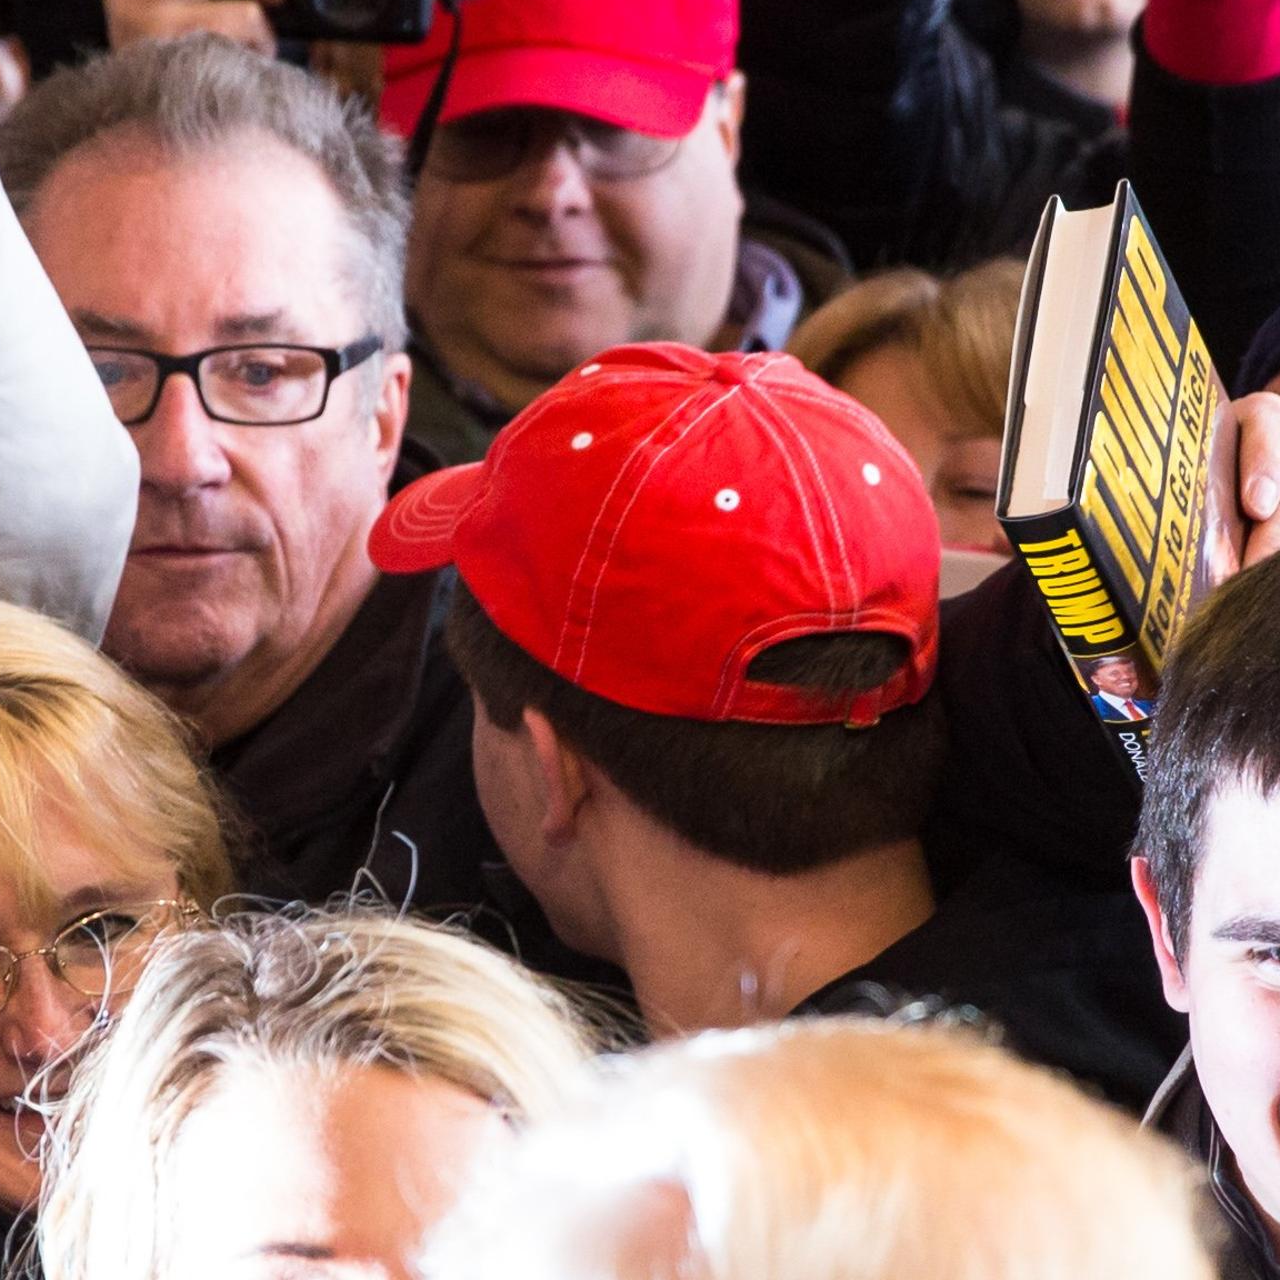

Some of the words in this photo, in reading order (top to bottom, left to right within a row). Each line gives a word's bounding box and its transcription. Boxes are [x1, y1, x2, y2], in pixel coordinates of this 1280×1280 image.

[1079, 213, 1183, 605] TRUMP
[1179, 348, 1209, 445] Rich
[1169, 437, 1194, 517] Get
[1019, 527, 1127, 645] TRUMP
[1163, 520, 1183, 567] to
[1144, 566, 1177, 660] How
